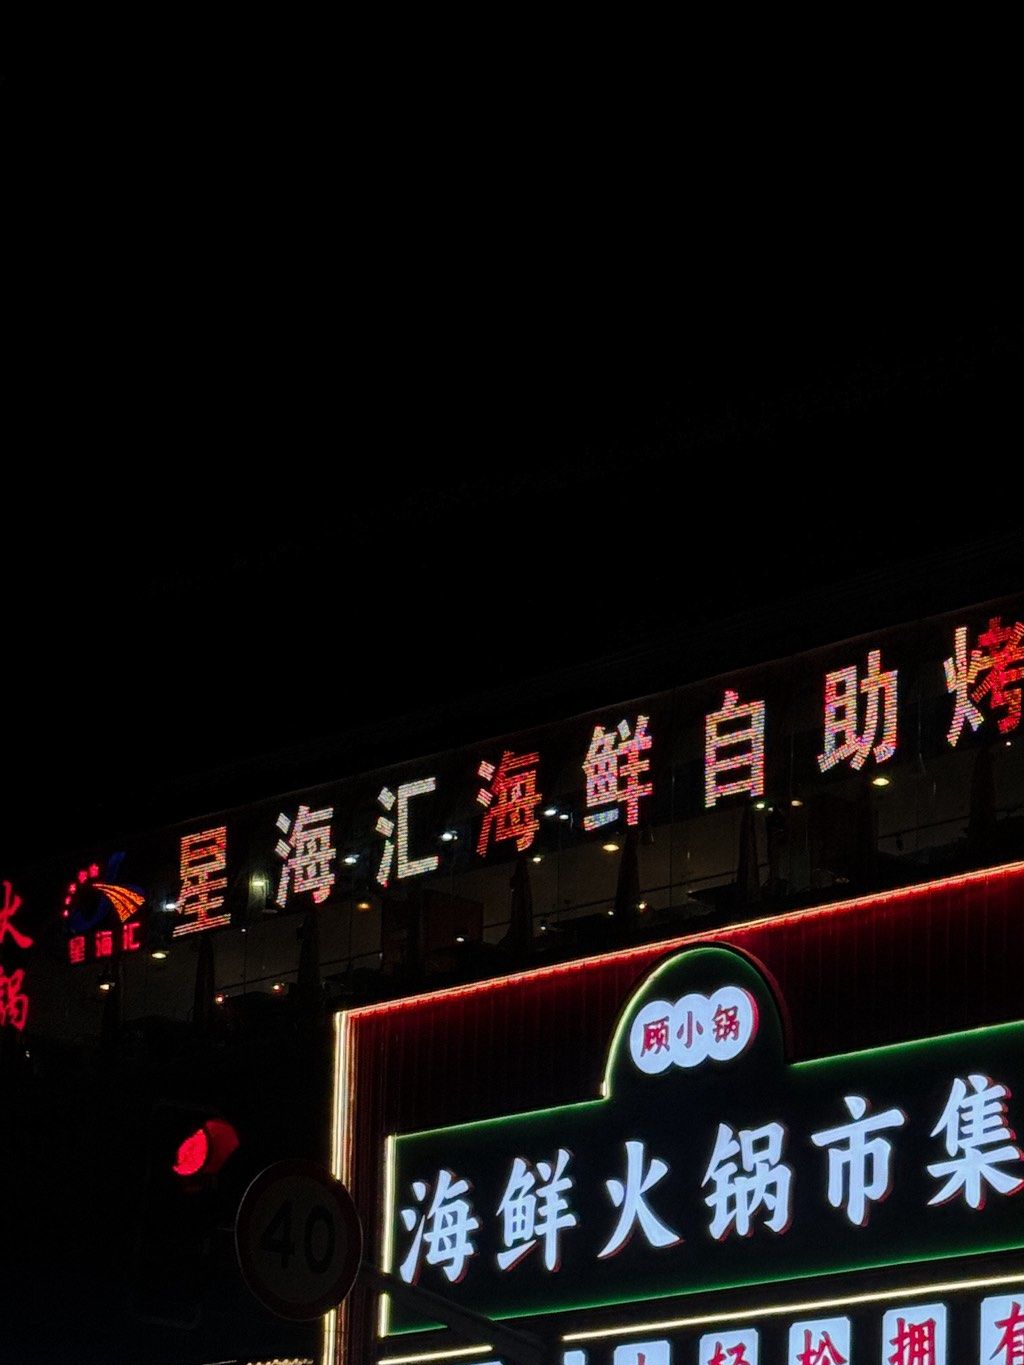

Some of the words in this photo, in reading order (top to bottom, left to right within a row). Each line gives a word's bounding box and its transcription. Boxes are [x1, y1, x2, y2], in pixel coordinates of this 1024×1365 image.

[69, 921, 141, 965] 星海汇
[639, 1002, 742, 1056] 顾小锅
[264, 1200, 336, 1274] 40
